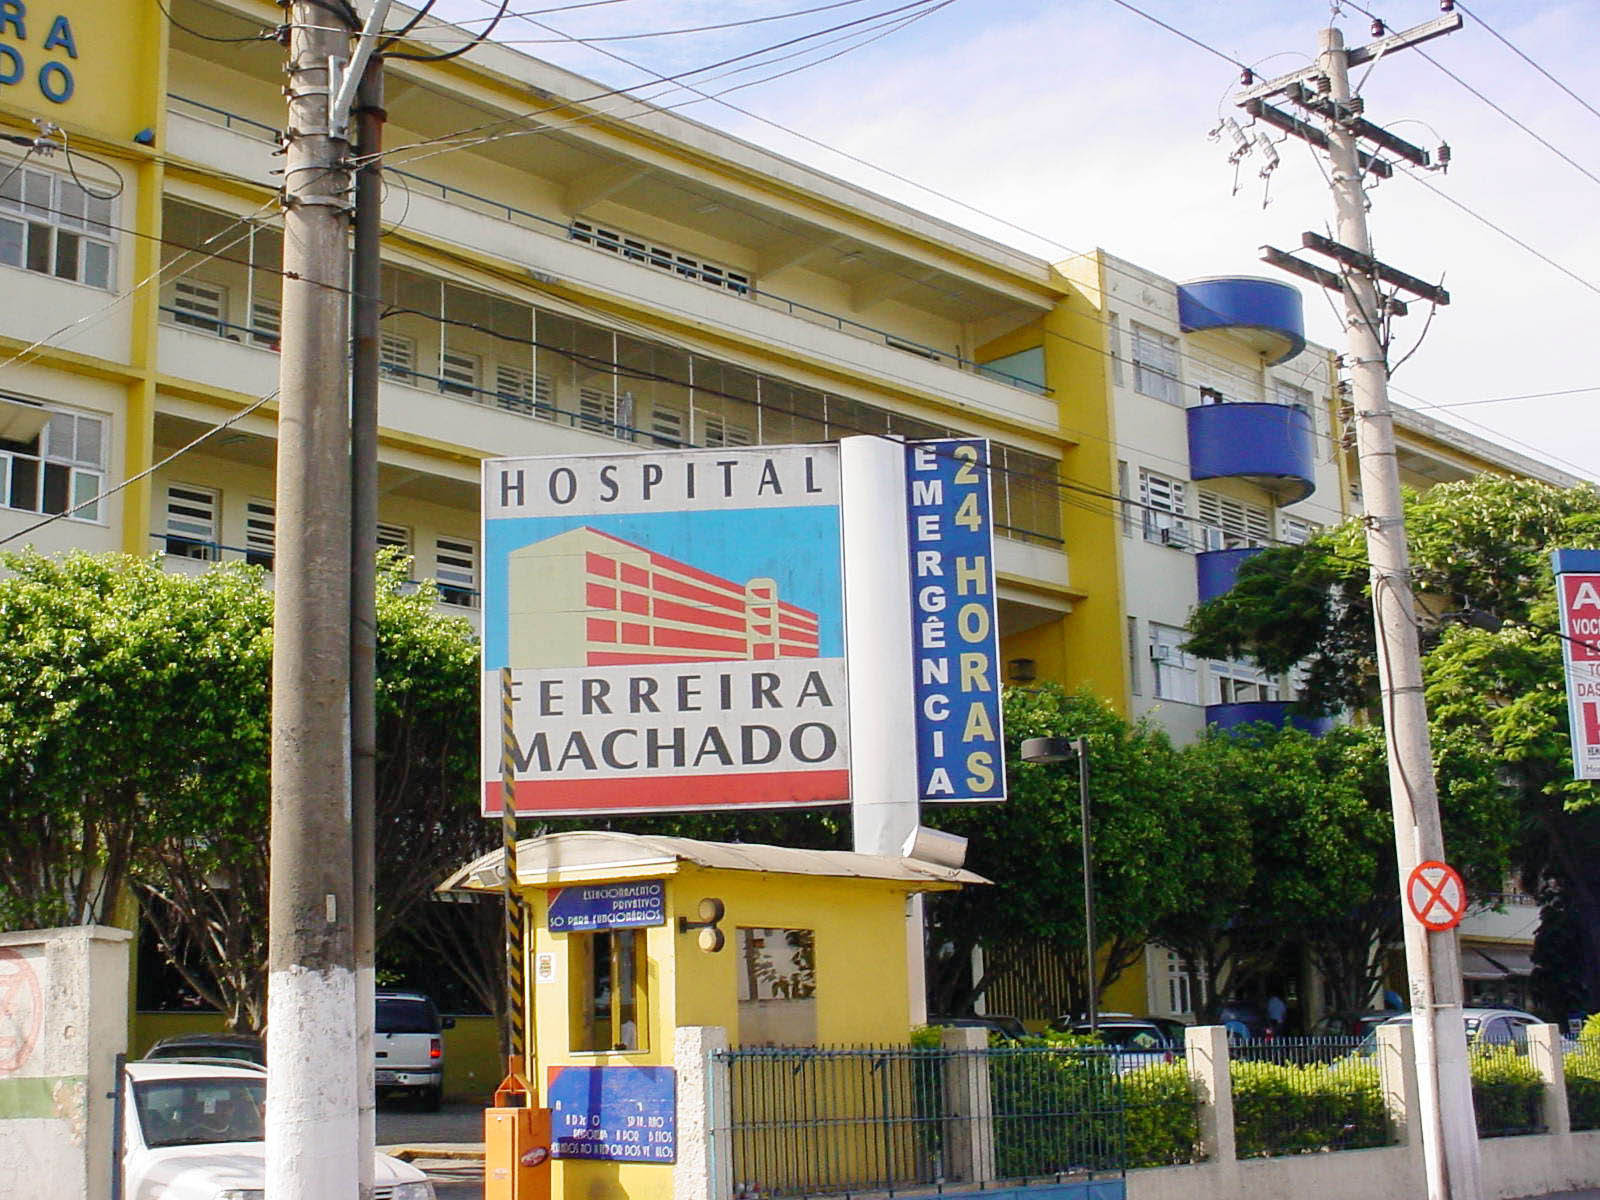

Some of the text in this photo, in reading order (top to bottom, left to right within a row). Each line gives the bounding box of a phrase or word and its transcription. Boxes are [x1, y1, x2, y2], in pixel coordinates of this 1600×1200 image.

[501, 457, 822, 507] HOSPITAL
[912, 445, 954, 795] EMERGÊNCIA
[954, 445, 996, 793] 24 HORAS
[499, 722, 837, 774] MACHADO
[612, 897, 660, 911] PRIVATIVO
